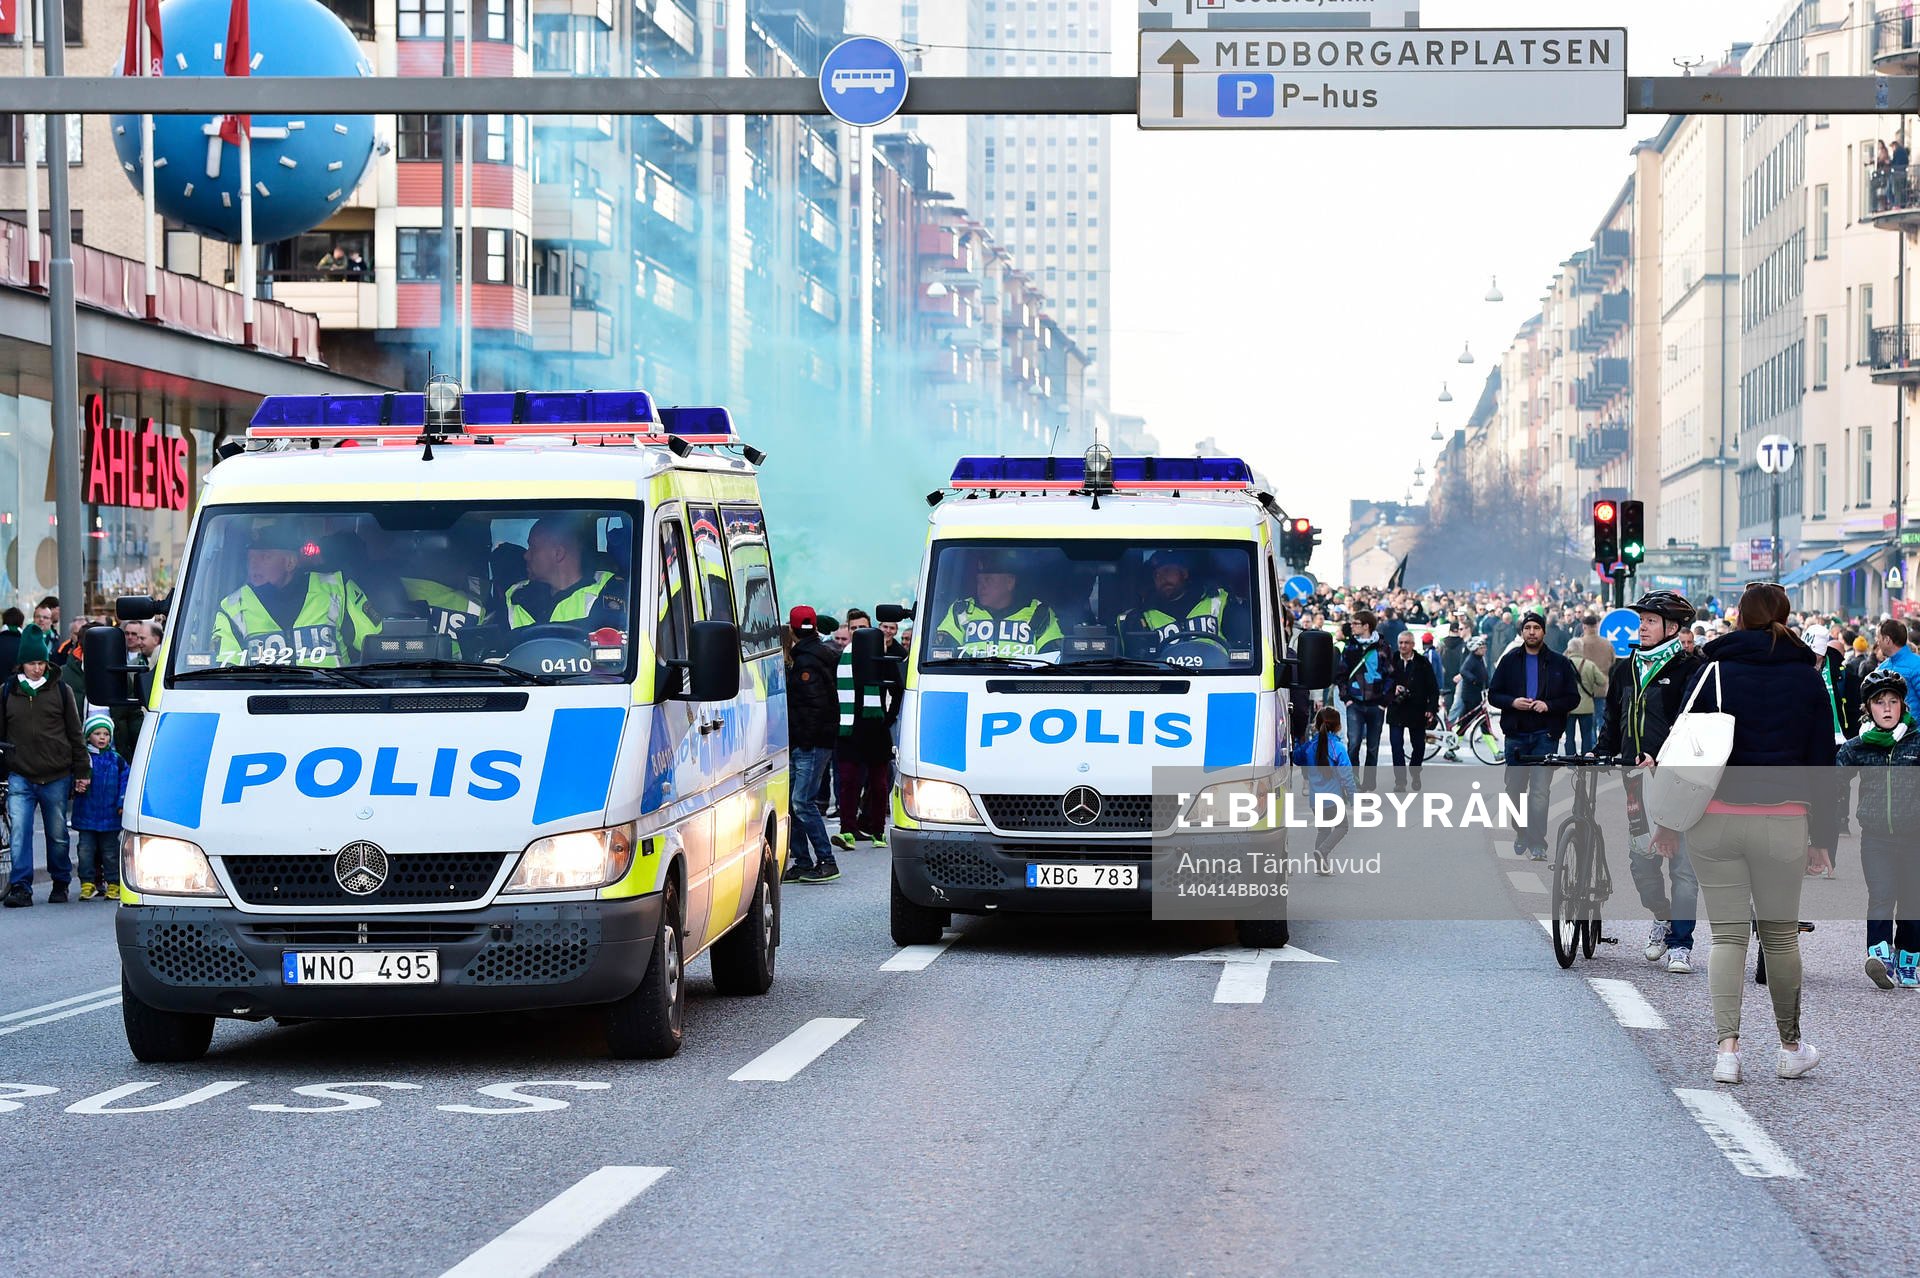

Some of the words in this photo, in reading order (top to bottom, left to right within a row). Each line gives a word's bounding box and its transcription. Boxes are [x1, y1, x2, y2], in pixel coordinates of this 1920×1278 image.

[1215, 38, 1610, 67] MEDBORGARPLATSEN
[1236, 80, 1258, 111] P
[1282, 83, 1378, 108] P-hus
[87, 393, 189, 512] ÅHLÉNS
[216, 646, 327, 667] 71-8210
[541, 658, 592, 673] 0410
[1166, 656, 1204, 667] 0429
[981, 708, 1193, 749] POLIS
[221, 747, 523, 804] POLIS
[1040, 867, 1078, 885] XBG
[1095, 868, 1133, 886] 783
[378, 955, 431, 980] 495
